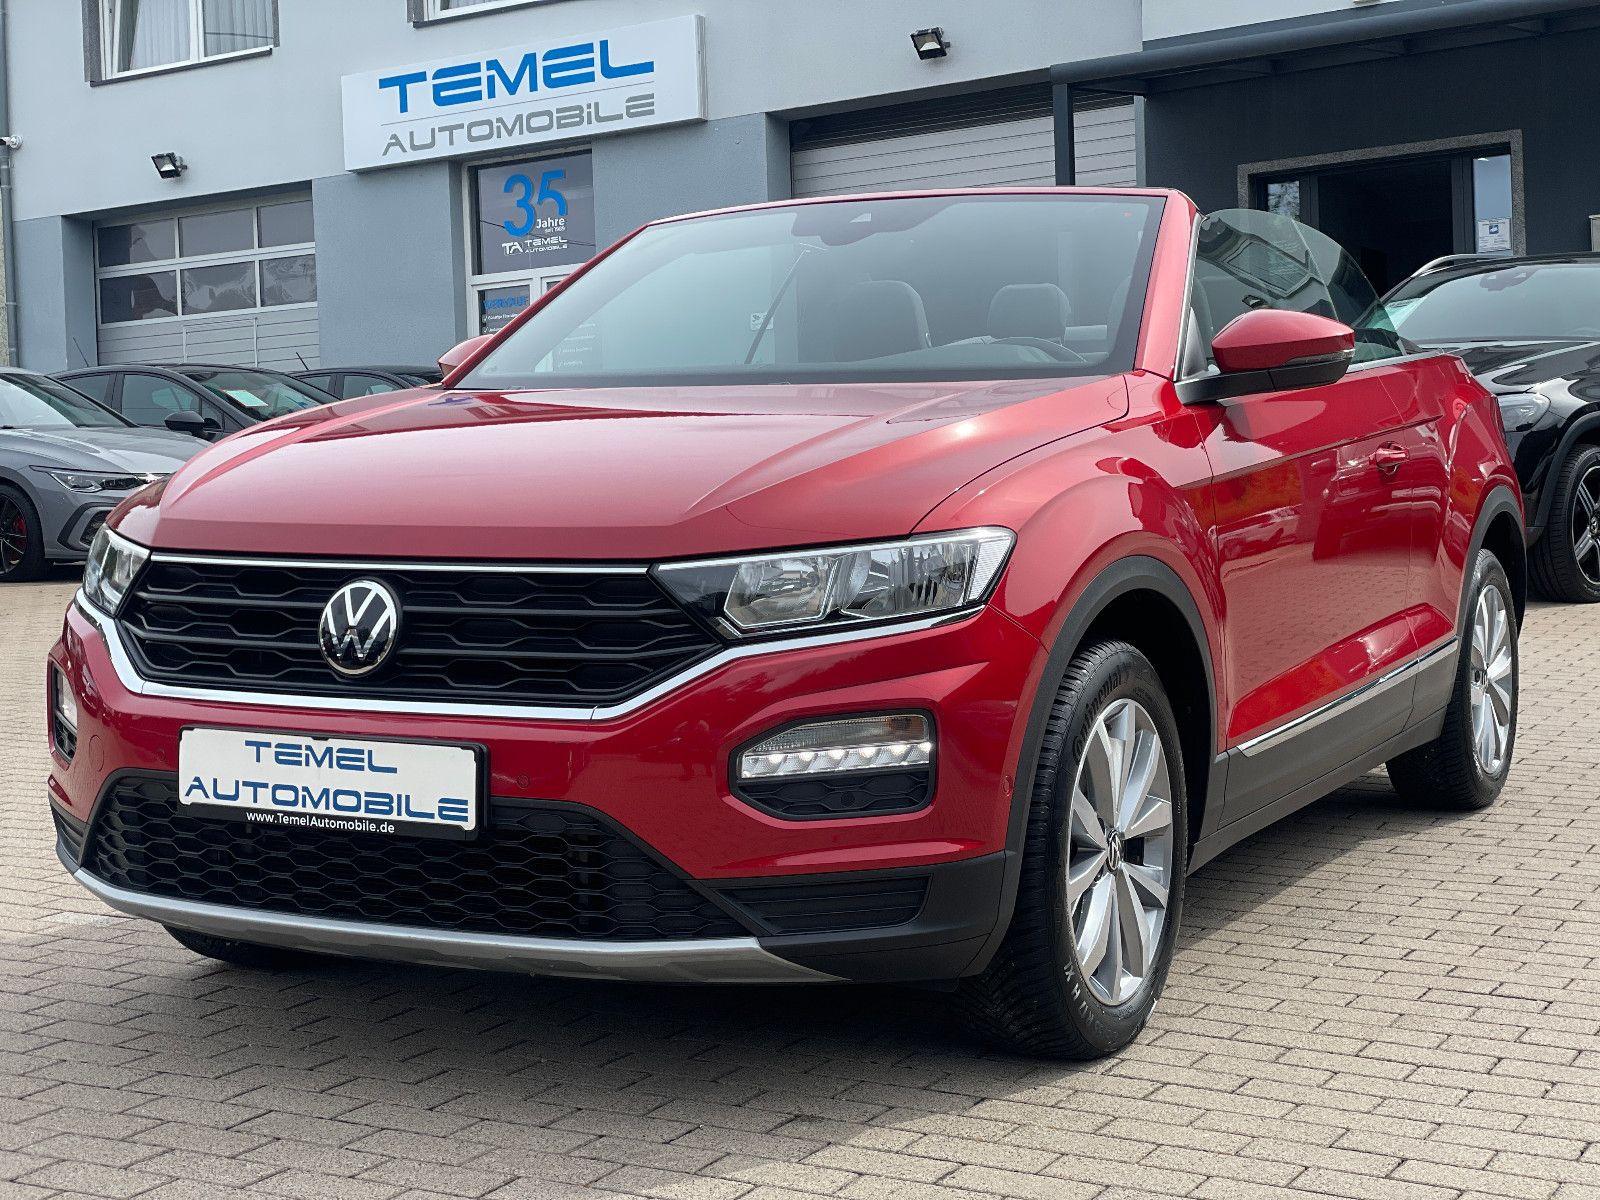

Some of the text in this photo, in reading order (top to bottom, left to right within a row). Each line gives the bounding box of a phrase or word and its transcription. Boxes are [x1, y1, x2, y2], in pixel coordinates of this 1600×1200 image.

[378, 39, 655, 114] TEMEL
[503, 168, 568, 238] 35
[536, 217, 565, 229] Jahre
[524, 235, 568, 247] TEMEL
[244, 739, 398, 774] TEMEL
[184, 775, 469, 823] AUTOMOBILE
[246, 810, 396, 834] www.TemelAutomobile.de
